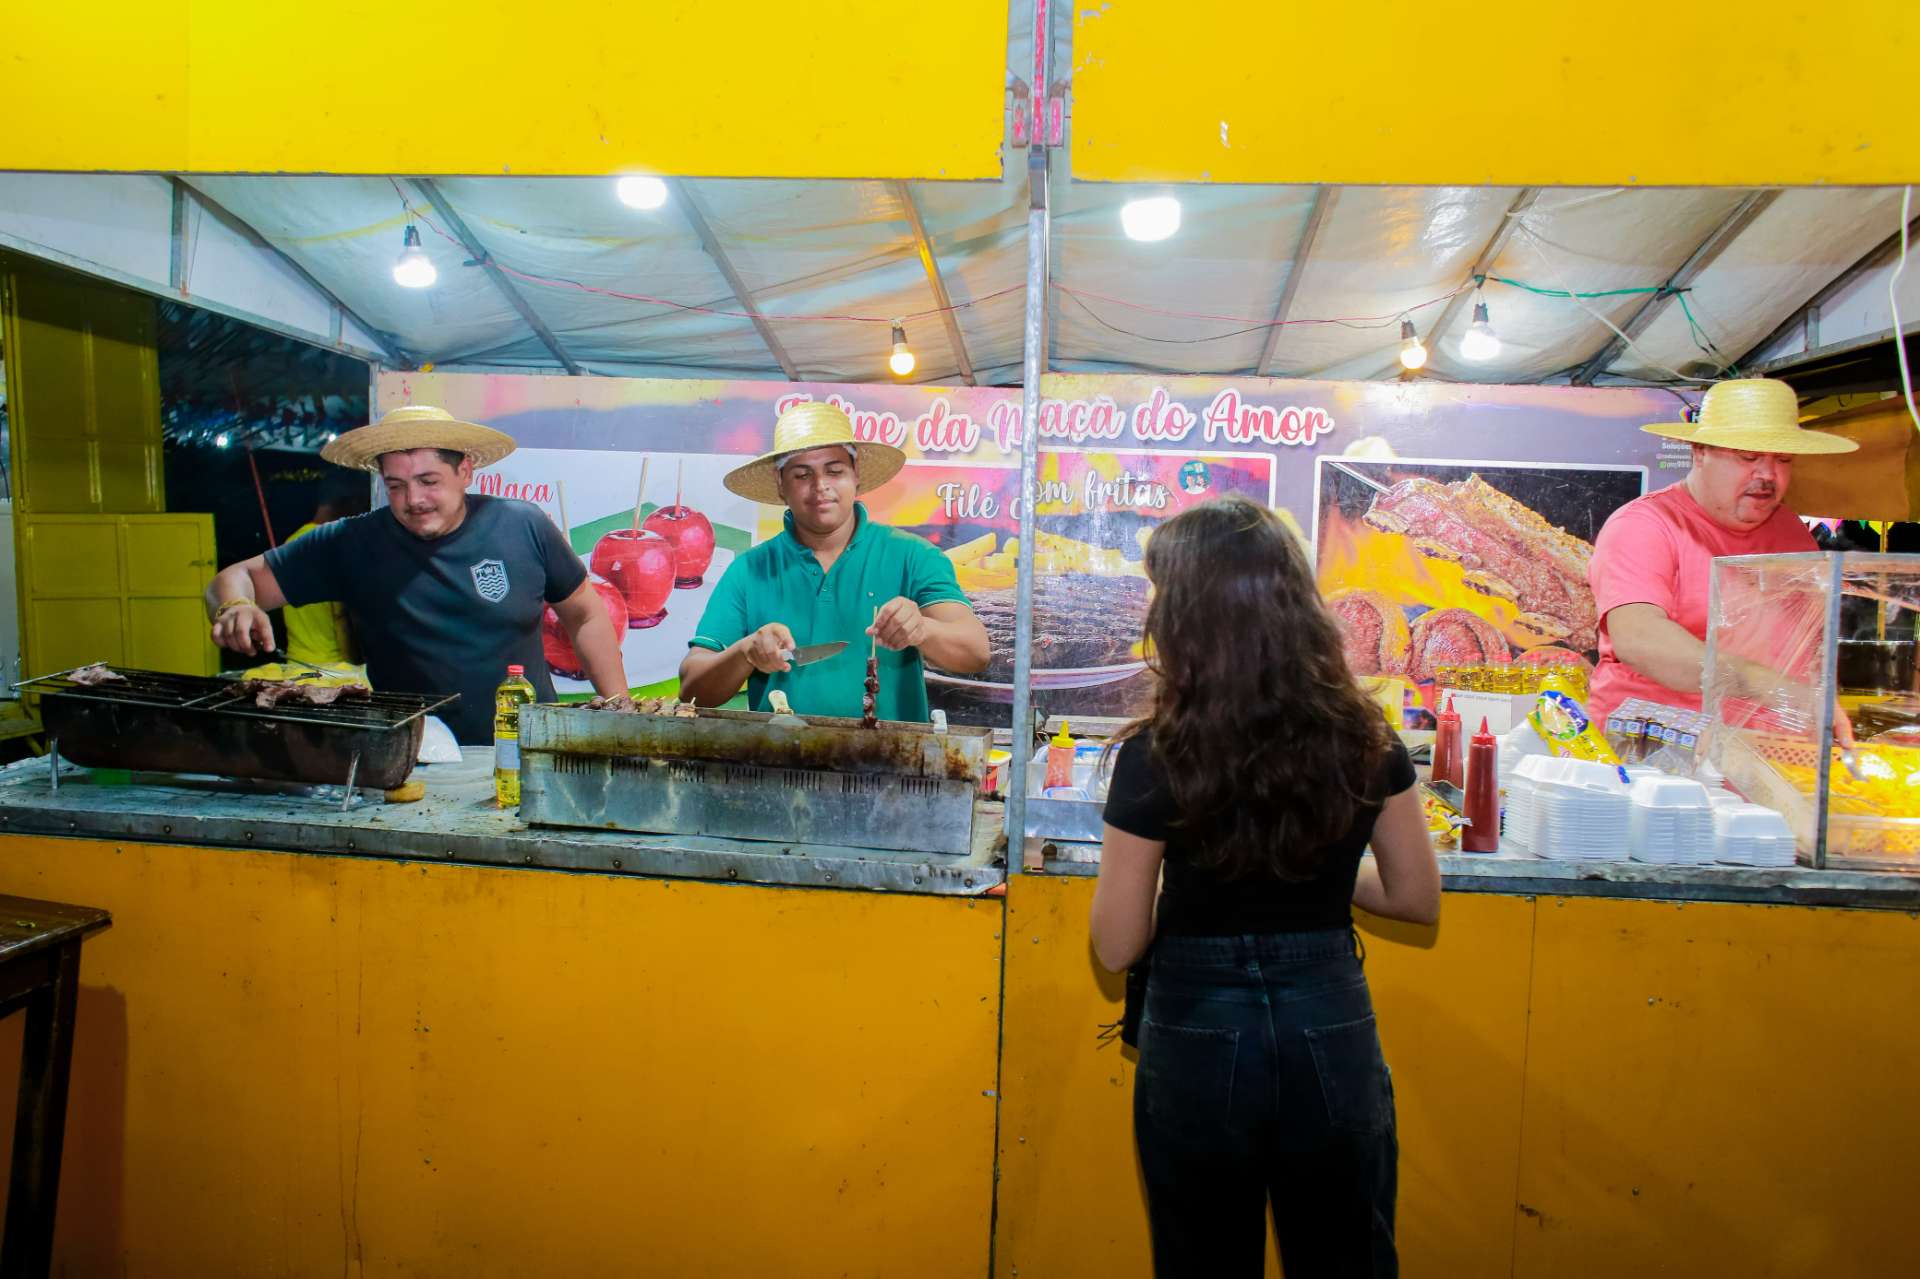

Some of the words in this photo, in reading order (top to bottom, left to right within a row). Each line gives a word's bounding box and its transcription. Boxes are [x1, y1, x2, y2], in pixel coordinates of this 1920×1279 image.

[915, 400, 979, 450] da
[1135, 389, 1195, 438] do
[1204, 391, 1331, 442] Amor
[937, 482, 999, 519] Filé
